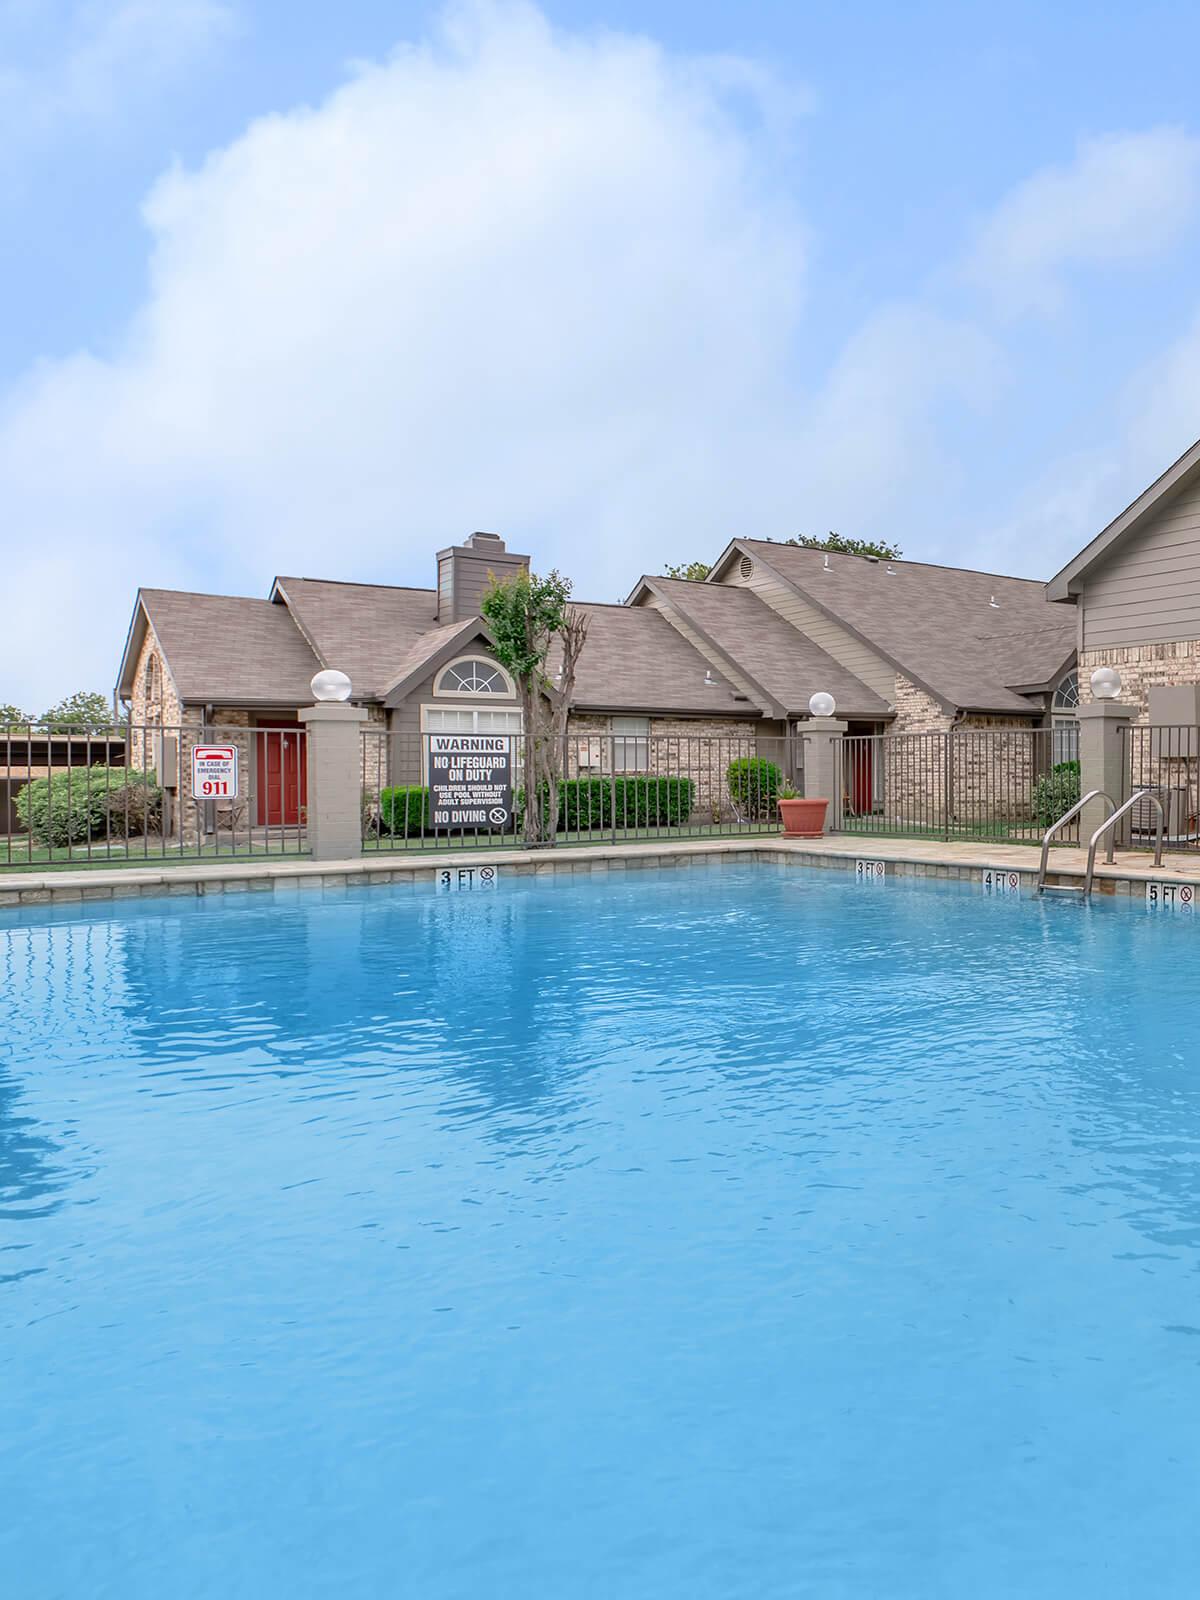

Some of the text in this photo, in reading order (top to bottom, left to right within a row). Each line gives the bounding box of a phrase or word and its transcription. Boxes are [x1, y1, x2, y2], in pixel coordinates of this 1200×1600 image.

[436, 739, 504, 750] WARNING
[434, 756, 506, 769] NO LIFEGUARD
[448, 769, 492, 781] ON DUTY
[202, 781, 227, 795] 911
[434, 810, 486, 823] NO DIVING
[857, 861, 864, 873] 3
[441, 869, 475, 883] 3 FT
[985, 871, 1006, 887] 4 FT
[1150, 885, 1177, 902] 5 FT
